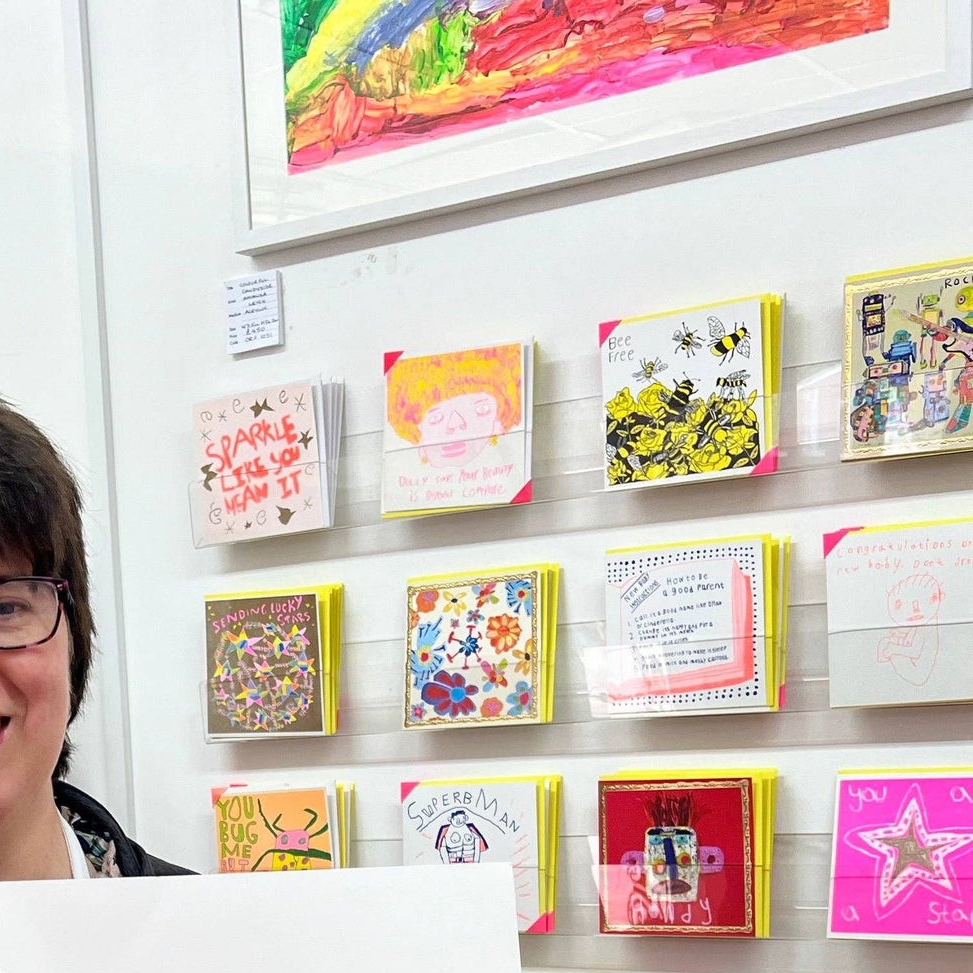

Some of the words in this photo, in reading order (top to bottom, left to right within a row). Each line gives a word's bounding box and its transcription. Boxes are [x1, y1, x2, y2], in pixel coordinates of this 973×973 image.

[945, 276, 973, 289] ROC
[608, 335, 632, 350] Bee
[608, 349, 635, 363] Free
[205, 414, 298, 473] SPARKLE
[220, 456, 269, 492] LIKE
[270, 446, 300, 475] YOU
[224, 483, 269, 516] MEAN
[277, 469, 302, 499] IT
[666, 575, 684, 586] How
[212, 603, 267, 634] SENDING
[270, 595, 303, 614] LUCKY
[276, 611, 311, 627] STARS
[217, 795, 255, 822] YOU
[847, 784, 888, 813] you
[218, 820, 259, 845] BUG
[221, 842, 252, 859] ME
